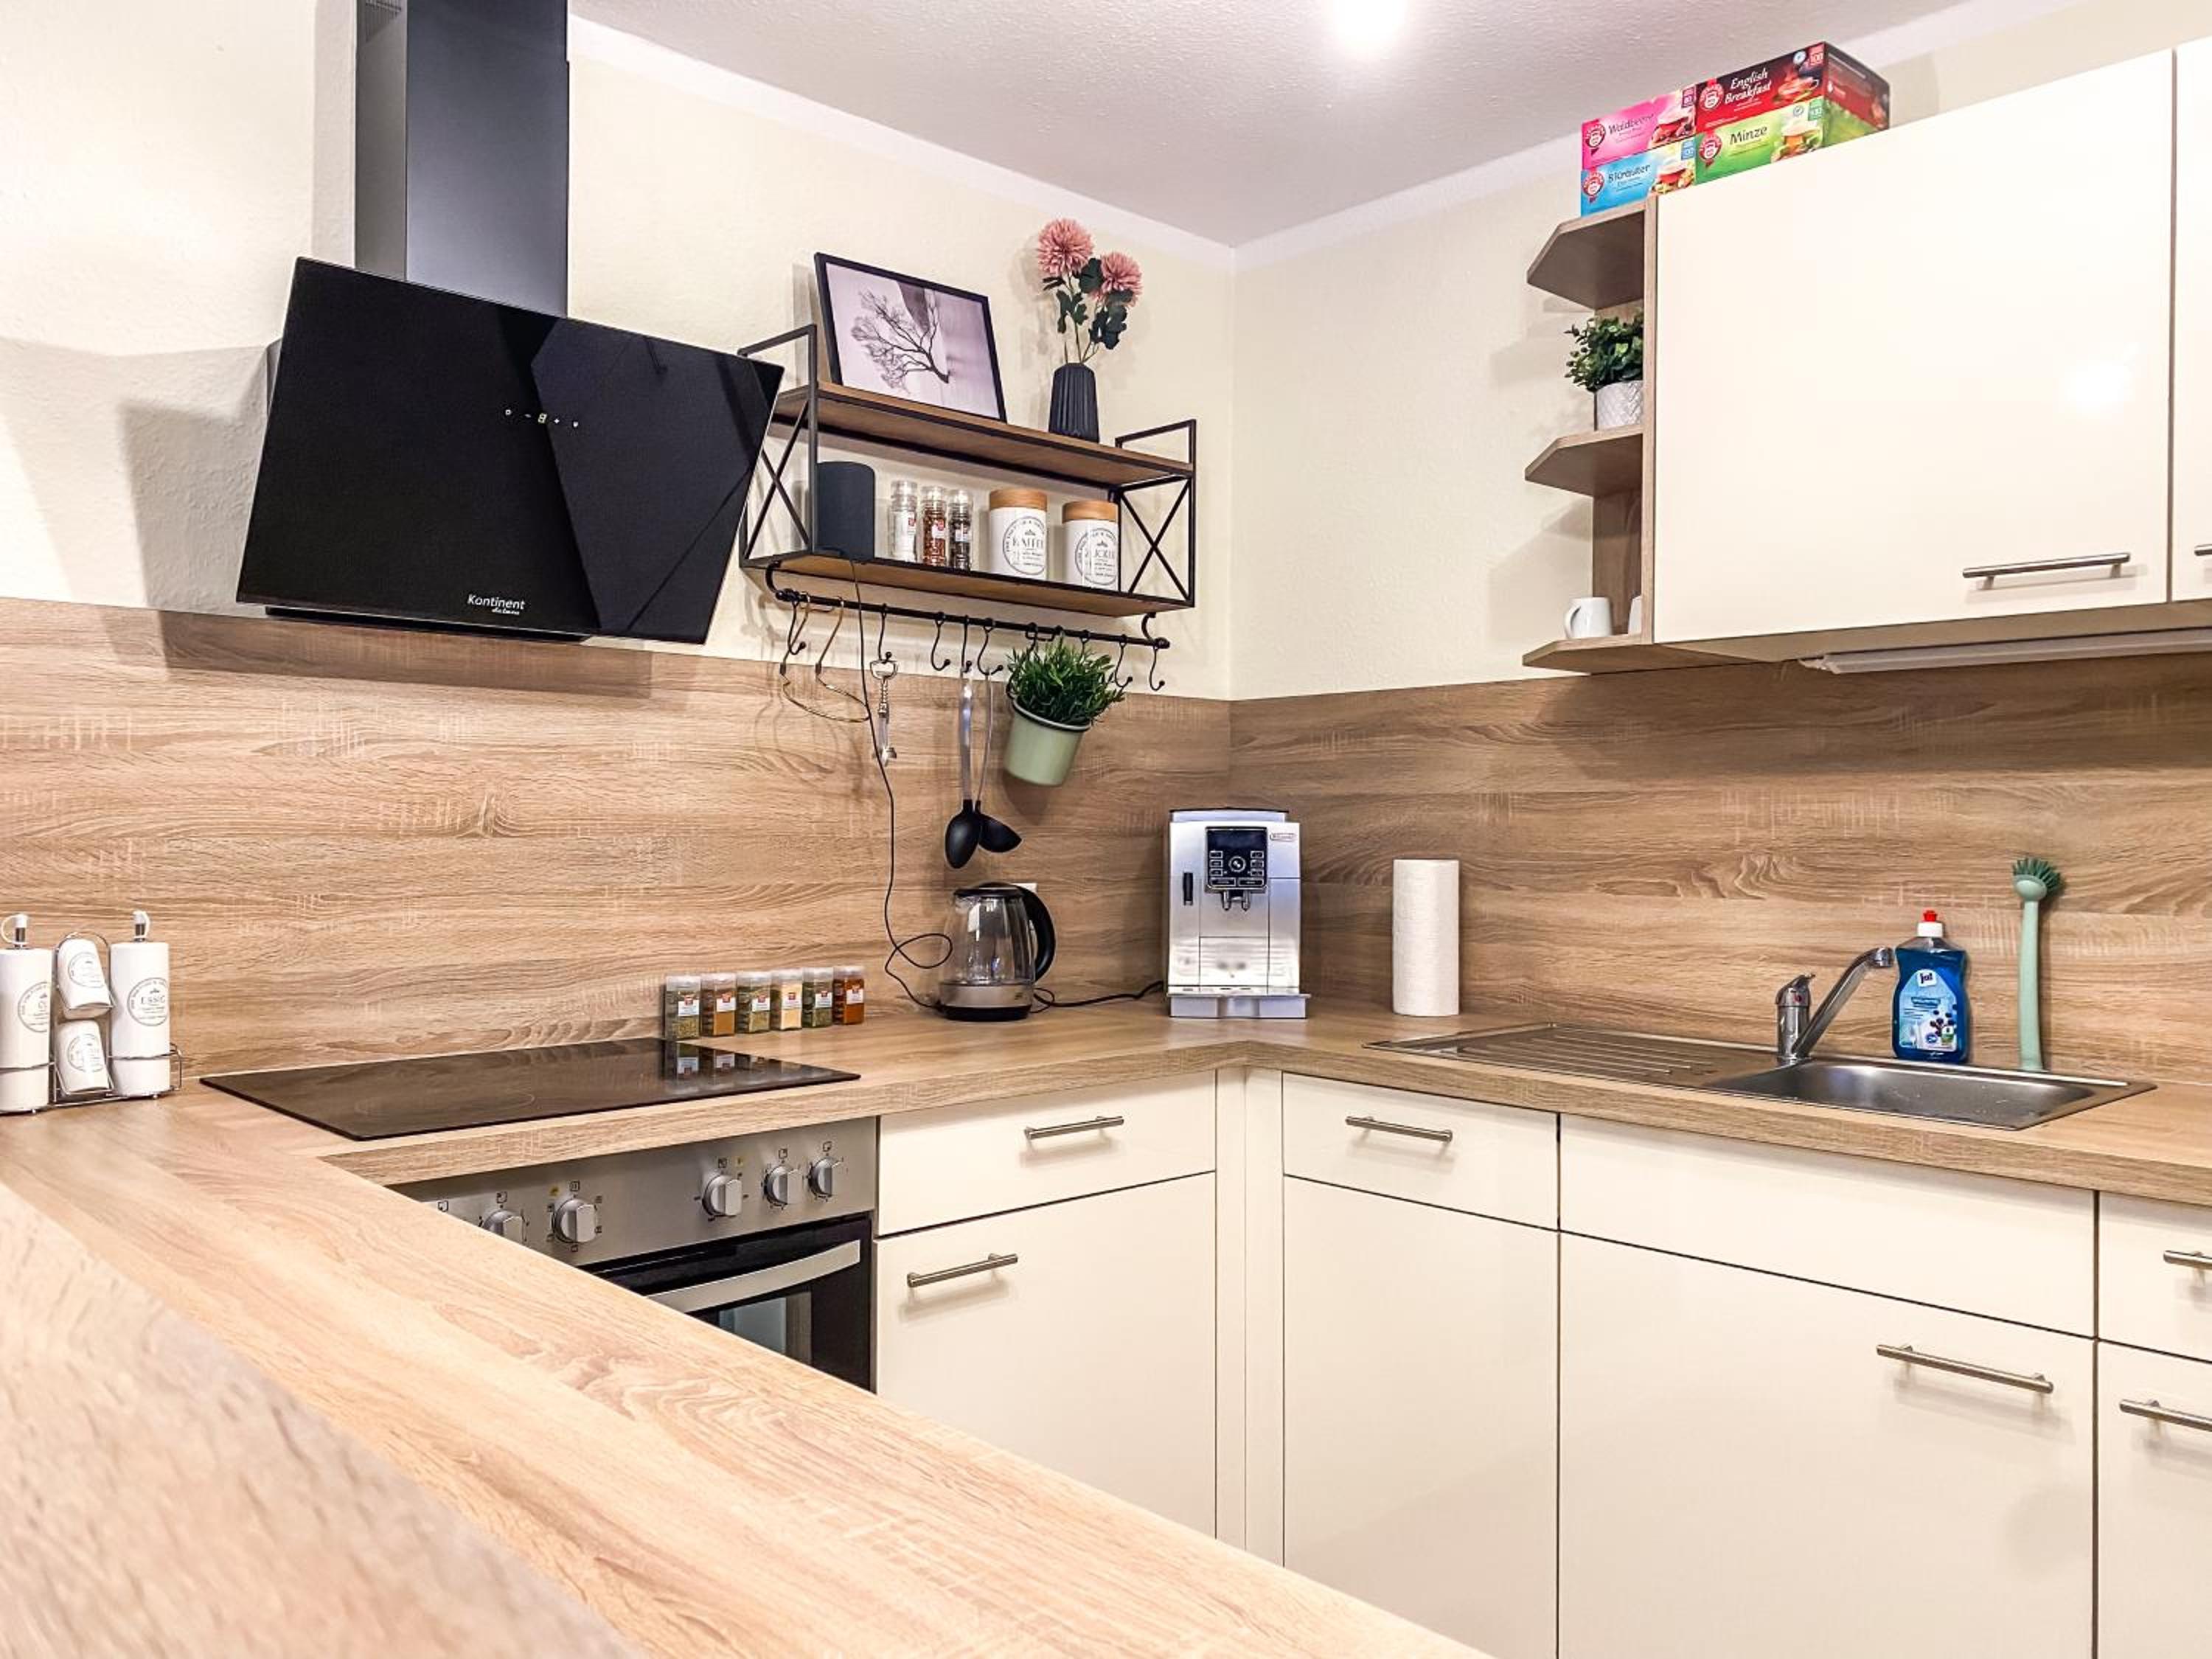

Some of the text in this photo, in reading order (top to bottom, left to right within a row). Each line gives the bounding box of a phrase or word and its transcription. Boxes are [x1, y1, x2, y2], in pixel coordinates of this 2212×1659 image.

[1731, 67, 1768, 89] English
[1725, 79, 1772, 105] Breakfast
[1730, 126, 1767, 145] Minze
[467, 594, 525, 610] Kontinent
